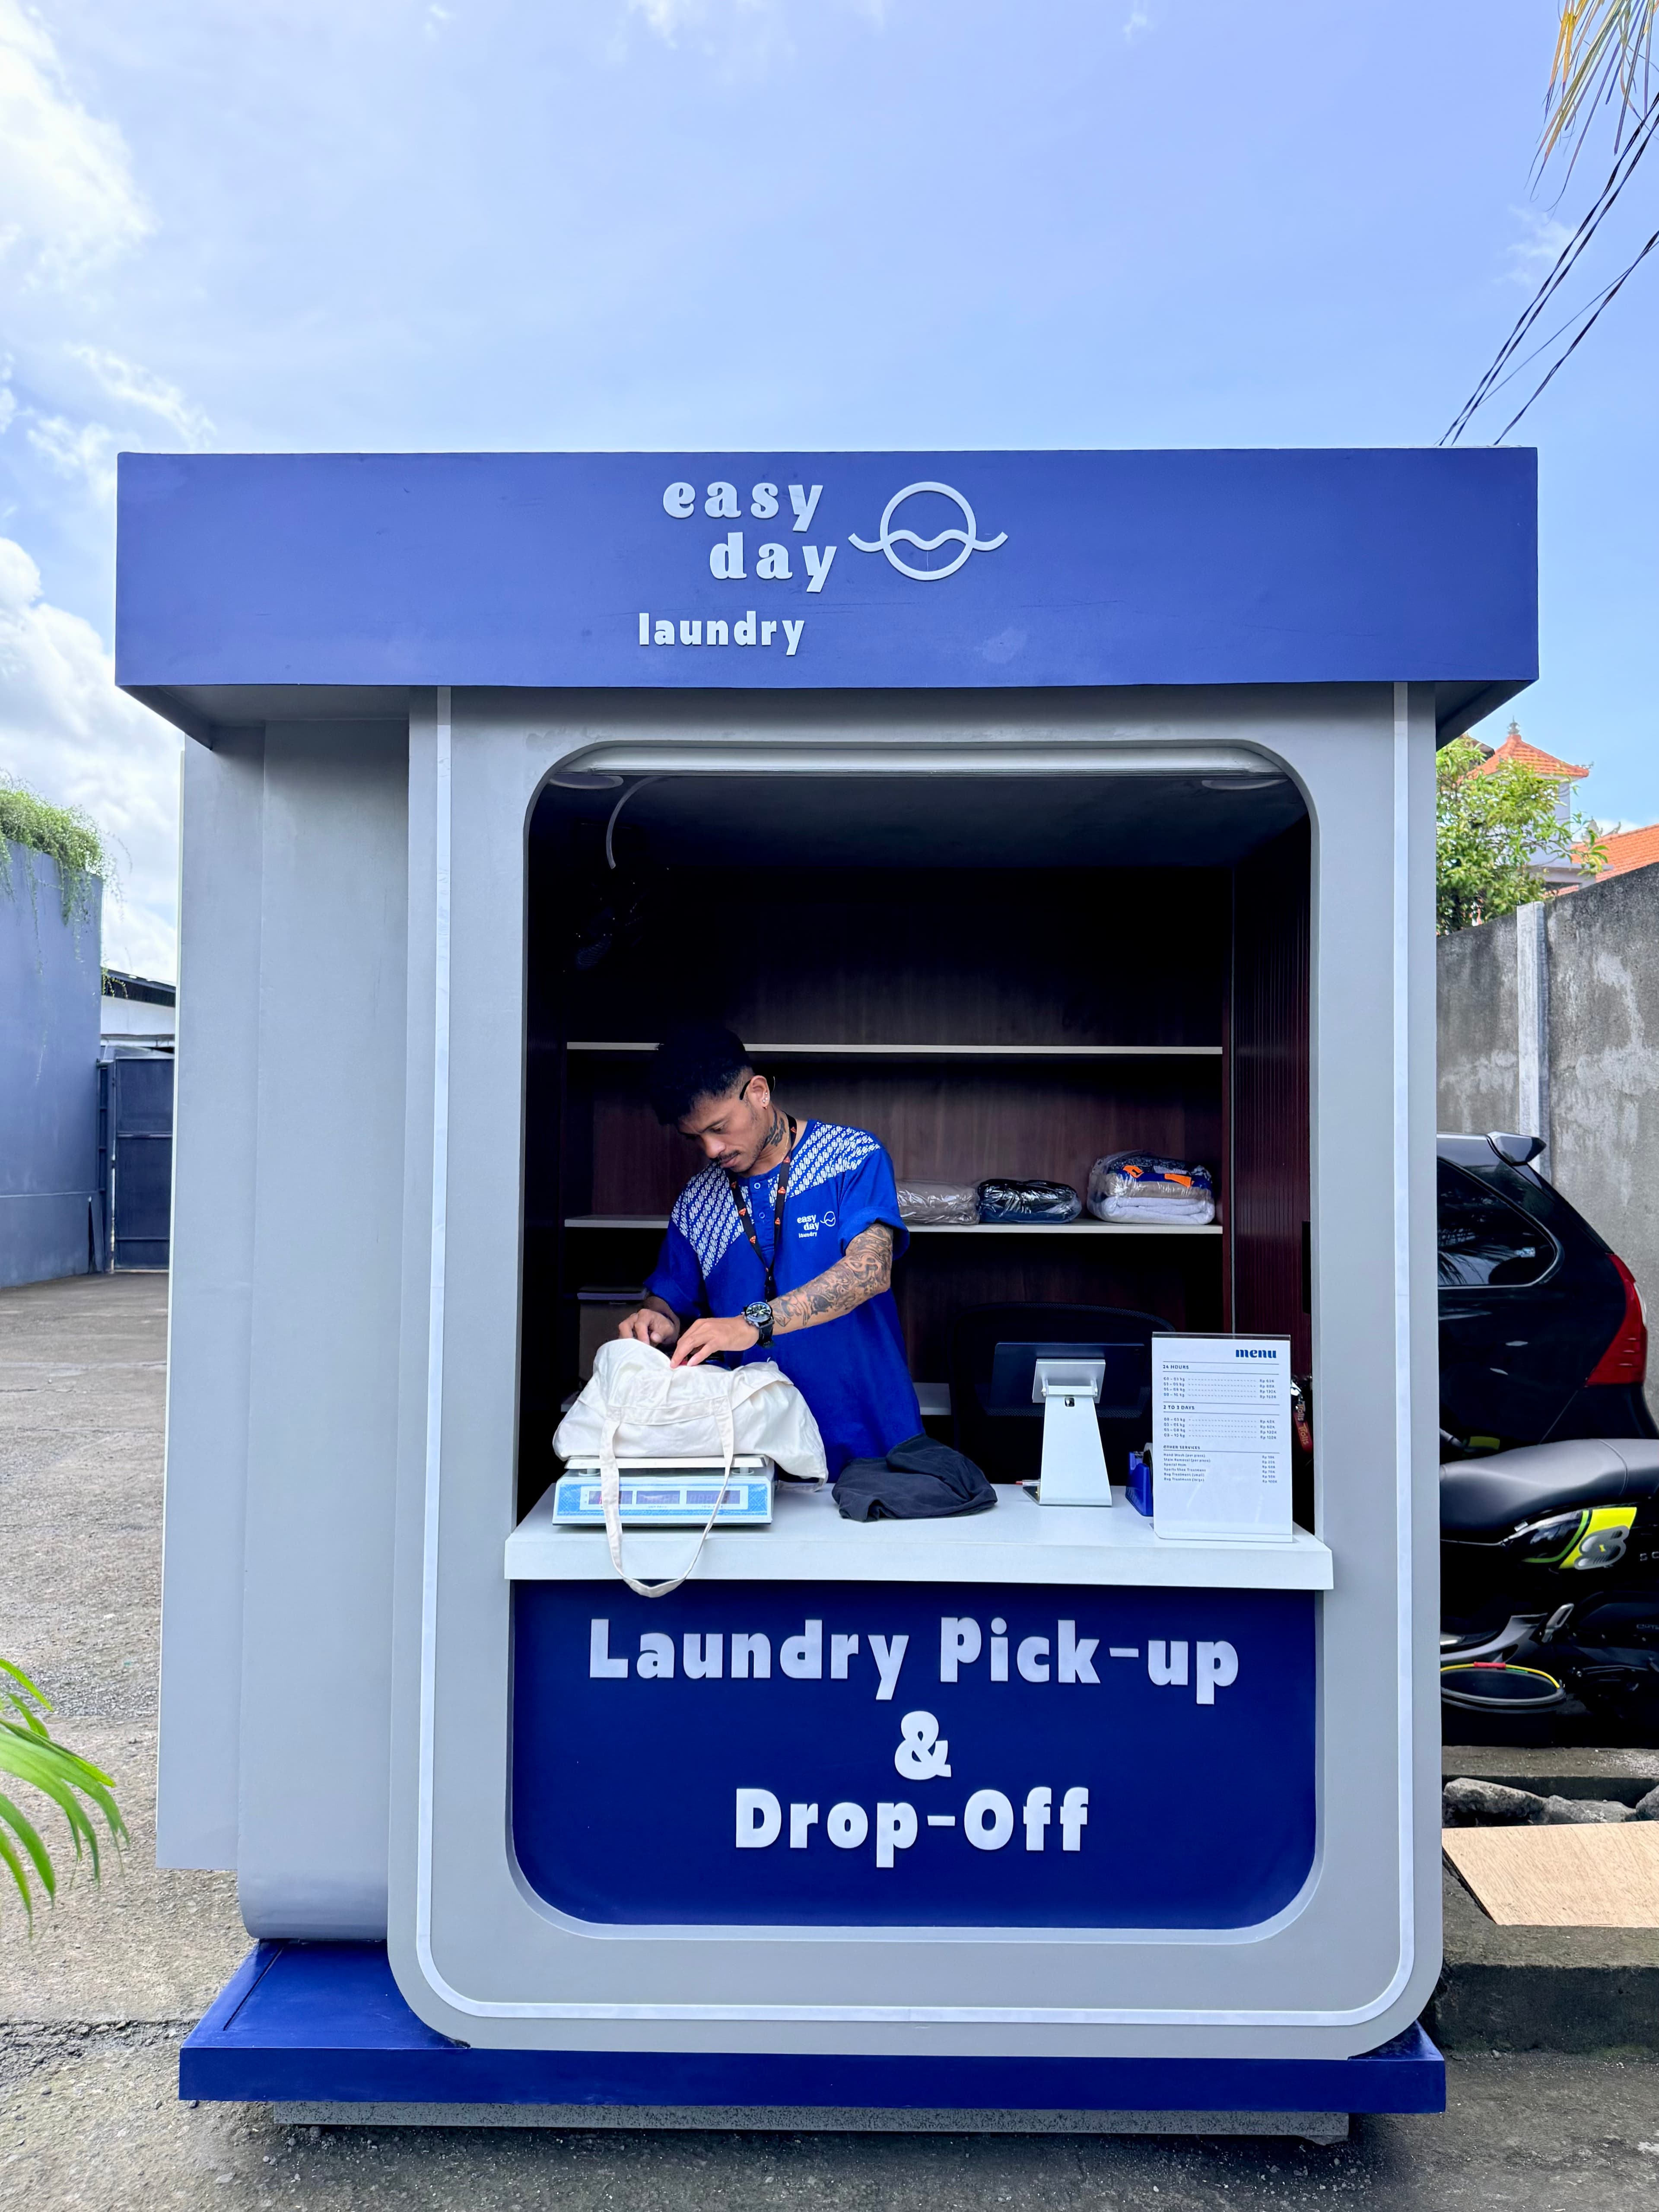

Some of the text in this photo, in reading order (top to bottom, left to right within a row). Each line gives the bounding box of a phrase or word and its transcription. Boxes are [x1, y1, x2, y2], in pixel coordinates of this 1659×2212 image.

[663, 481, 823, 532] easy
[709, 531, 837, 593] day
[639, 610, 805, 656] laundry
[797, 1214, 816, 1223] easy
[804, 1222, 819, 1230] day
[1236, 1350, 1277, 1358] menu
[590, 1617, 1239, 1705] Laundry Pick-up
[894, 1710, 952, 1780] &
[735, 1786, 1090, 1869] Drop-Off
